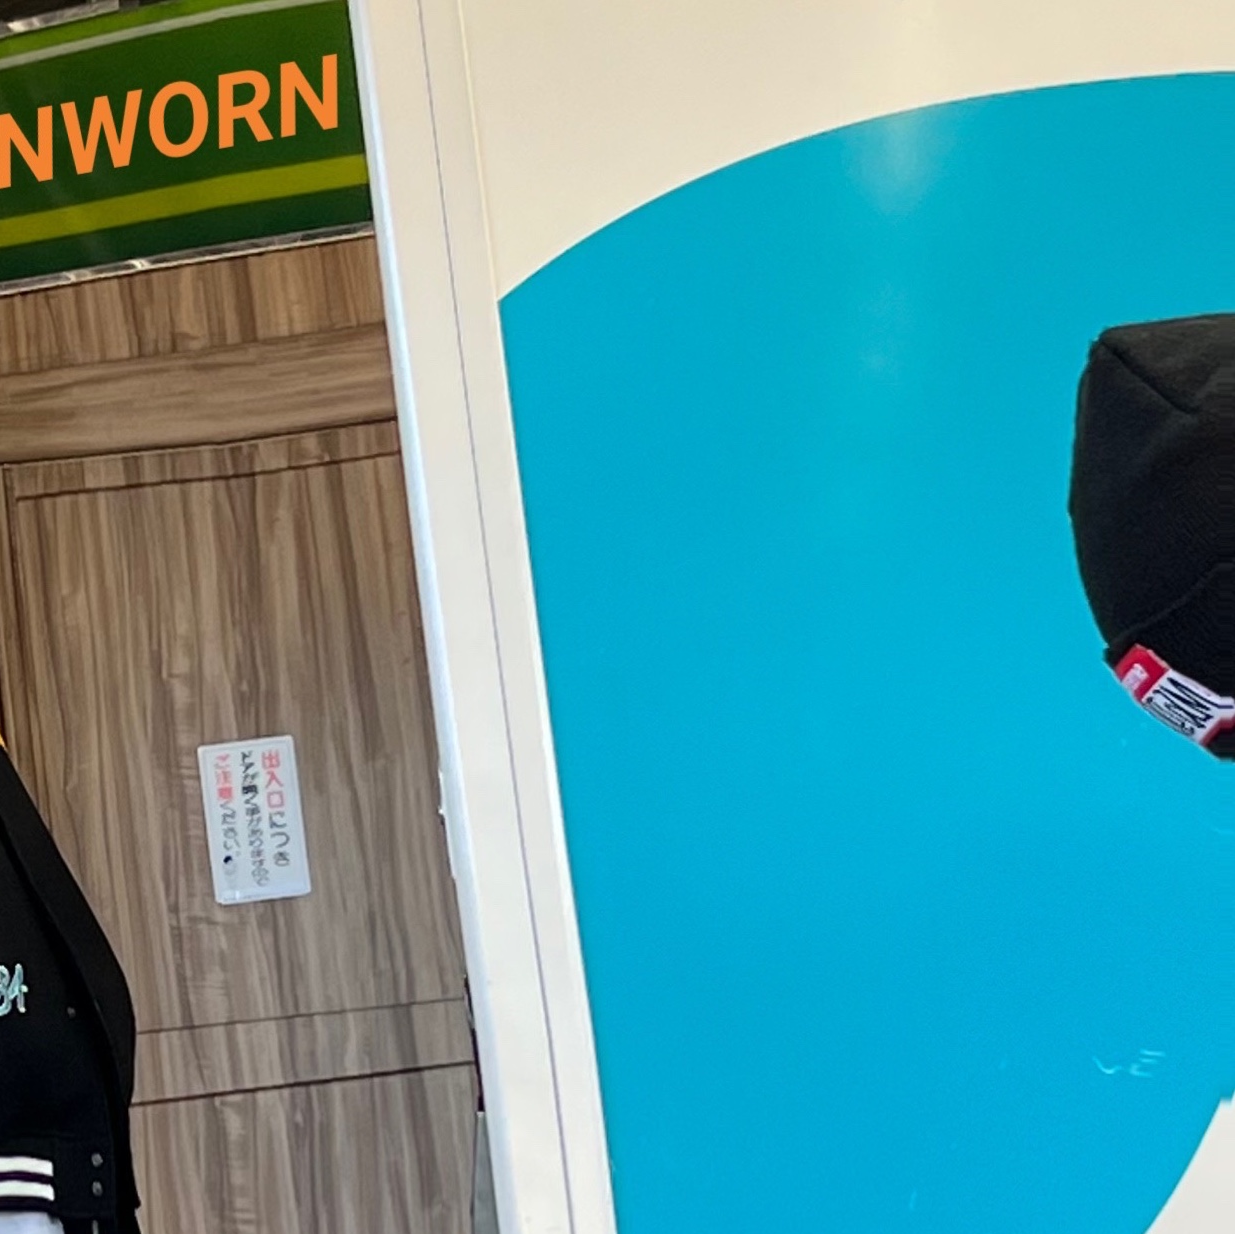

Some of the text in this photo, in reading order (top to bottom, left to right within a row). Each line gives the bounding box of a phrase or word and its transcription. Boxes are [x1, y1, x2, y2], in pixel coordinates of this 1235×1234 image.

[260, 749, 291, 867] 出入口につき
